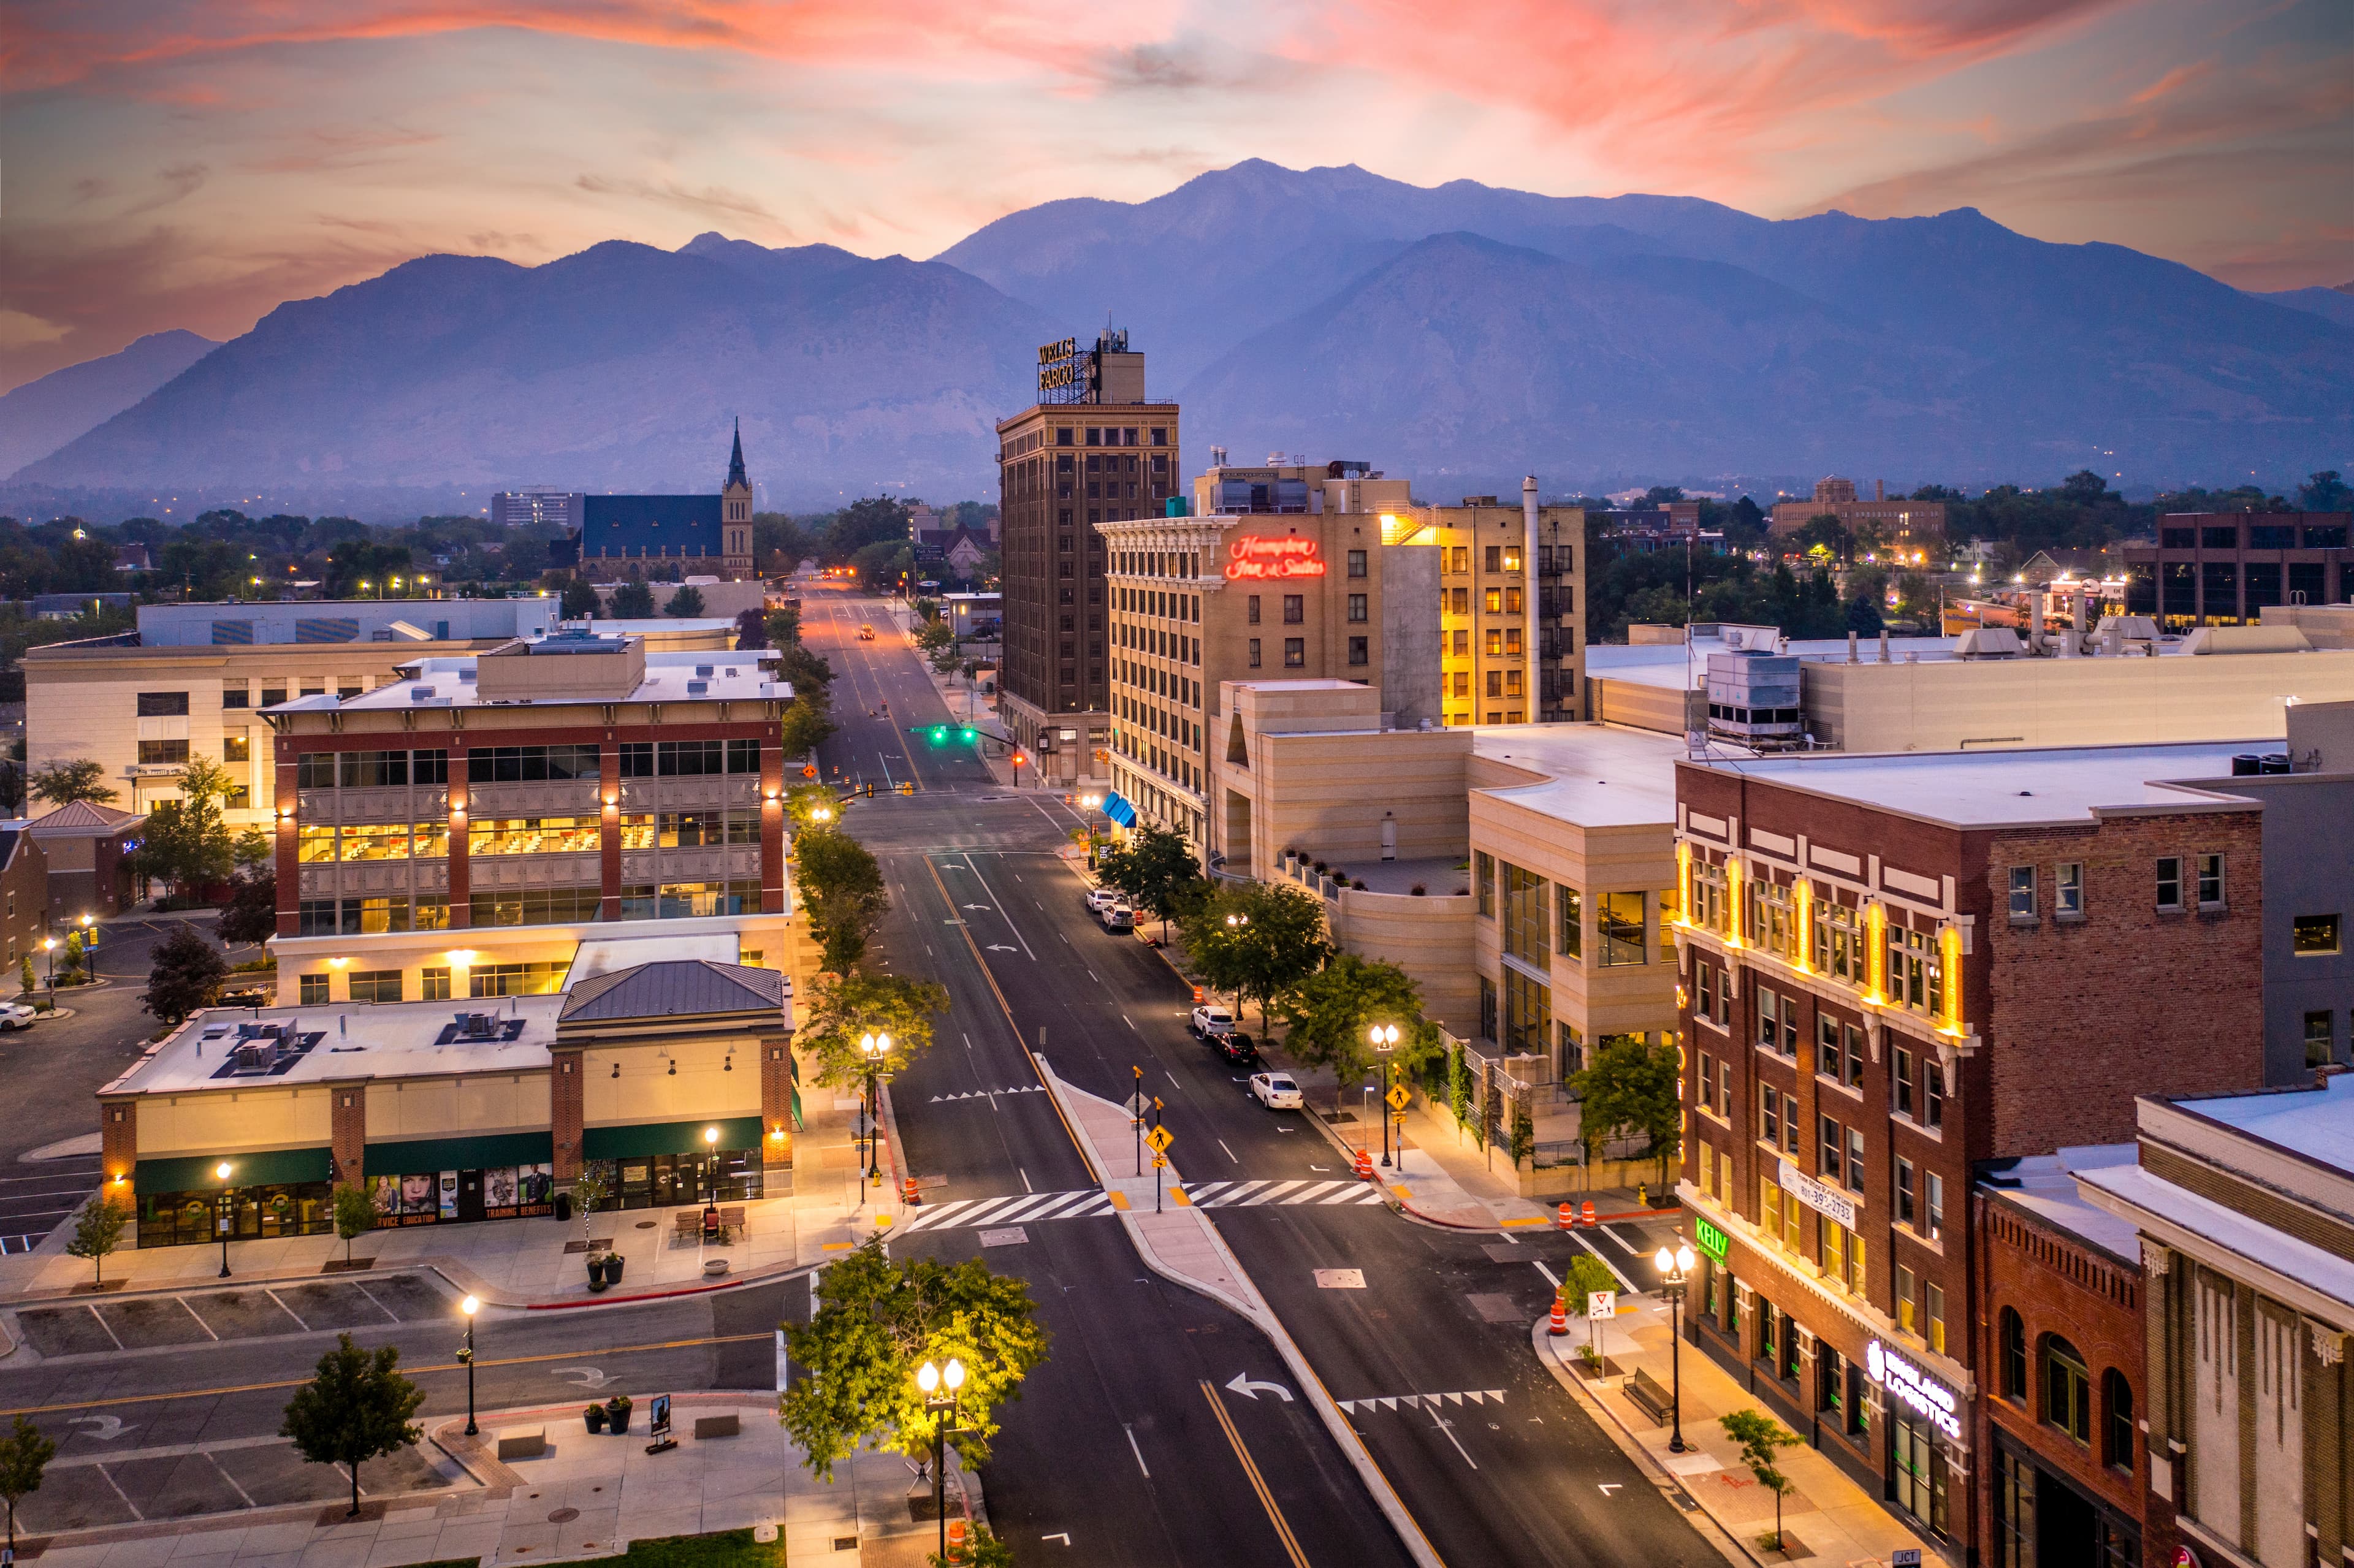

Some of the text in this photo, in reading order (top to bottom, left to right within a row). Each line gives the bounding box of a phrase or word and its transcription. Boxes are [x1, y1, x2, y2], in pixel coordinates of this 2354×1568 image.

[1038, 337, 1074, 365] WELLS
[1039, 364, 1073, 391] FARGO
[1230, 536, 1316, 559] Hampton
[1226, 558, 1266, 579] Inn
[1280, 558, 1325, 576] Suites
[403, 1214, 436, 1225] EDUCATION
[486, 1205, 552, 1219] TRAINING BENEFITS
[1696, 1216, 1728, 1257] KELLY
[1696, 1242, 1726, 1268] SERVICES
[1885, 1350, 1954, 1413] ENGLAND
[1885, 1369, 1960, 1438] LOGISTICS
[1899, 1551, 1915, 1562] JCT
